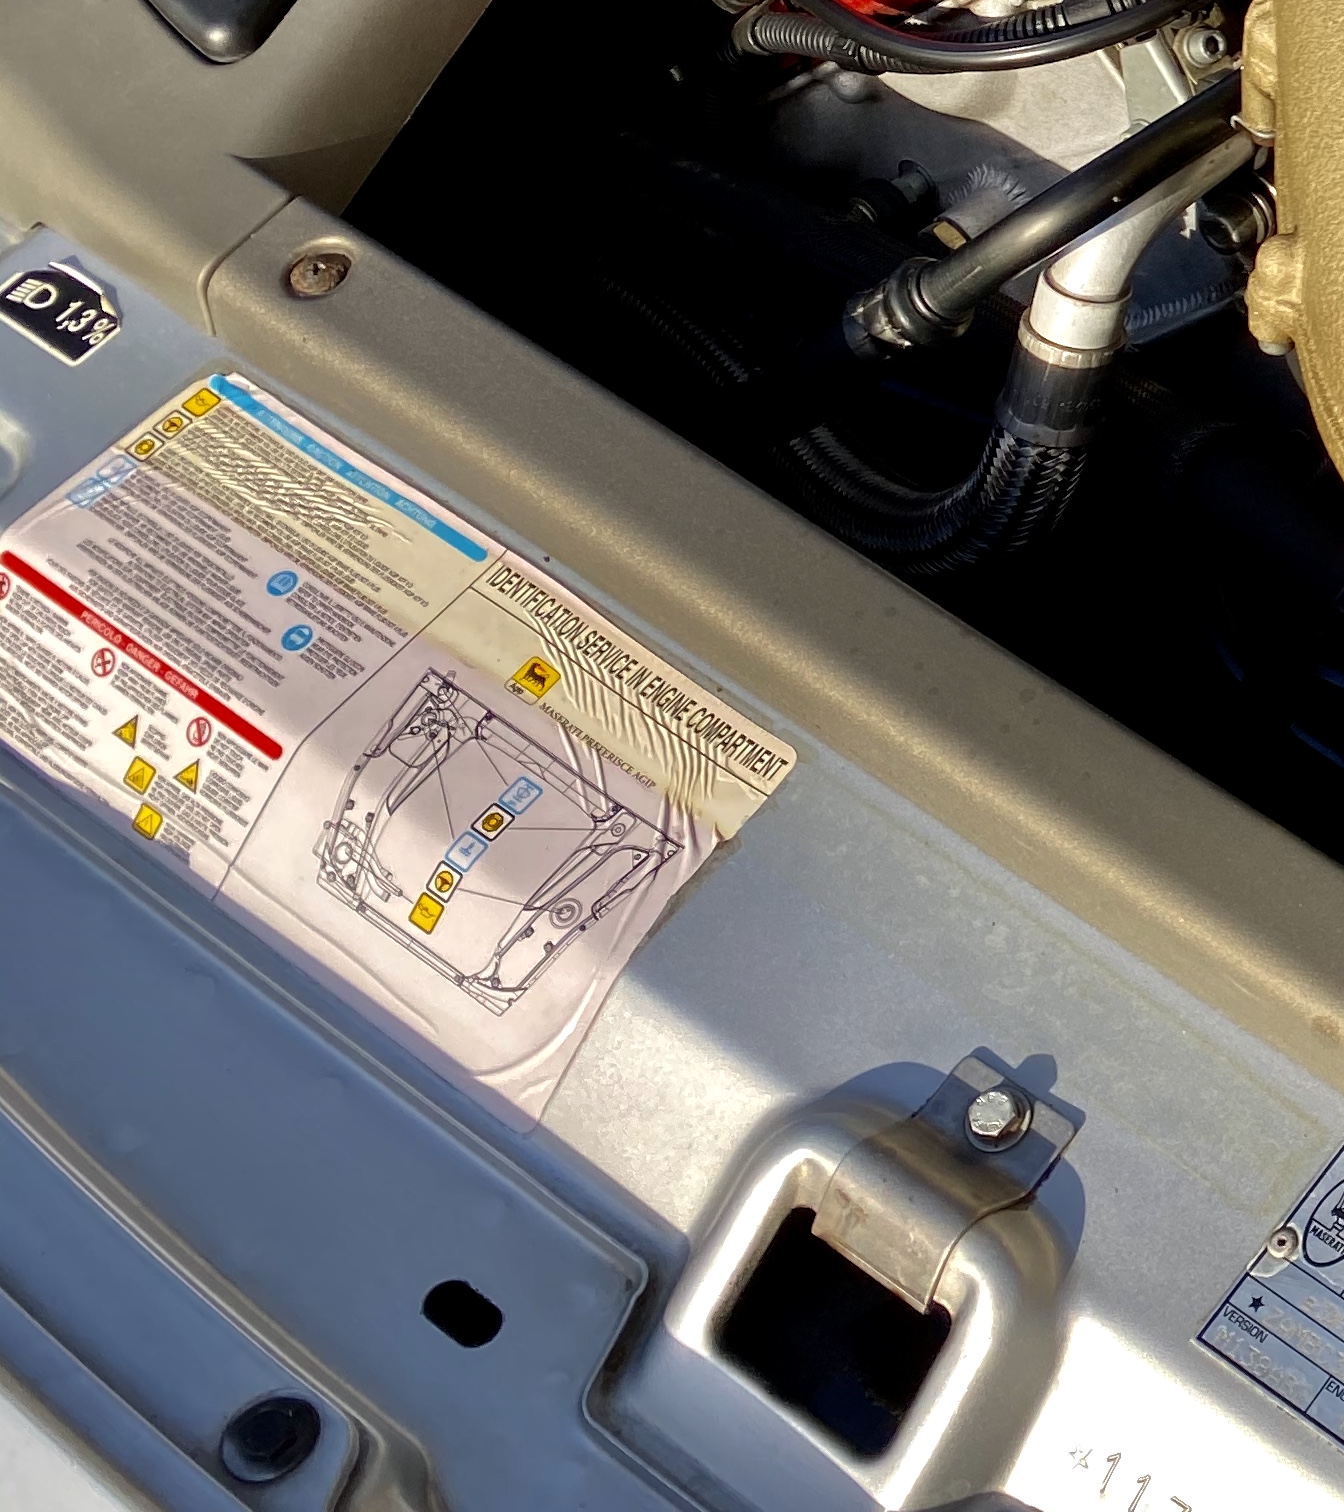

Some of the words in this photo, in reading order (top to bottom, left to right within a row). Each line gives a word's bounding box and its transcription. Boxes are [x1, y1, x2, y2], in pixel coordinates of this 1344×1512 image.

[79, 608, 124, 645] PERICOLO
[124, 641, 161, 673] DANGER
[487, 565, 588, 642] IDENTIFICATION
[576, 631, 638, 682] SERVICE
[625, 666, 653, 695] IN
[639, 676, 697, 725] ENGINE
[686, 708, 788, 781] COMPARTMENT
[539, 701, 583, 740] MASERATI
[631, 771, 657, 789] AGIP
[1223, 1306, 1269, 1344] VERSION
